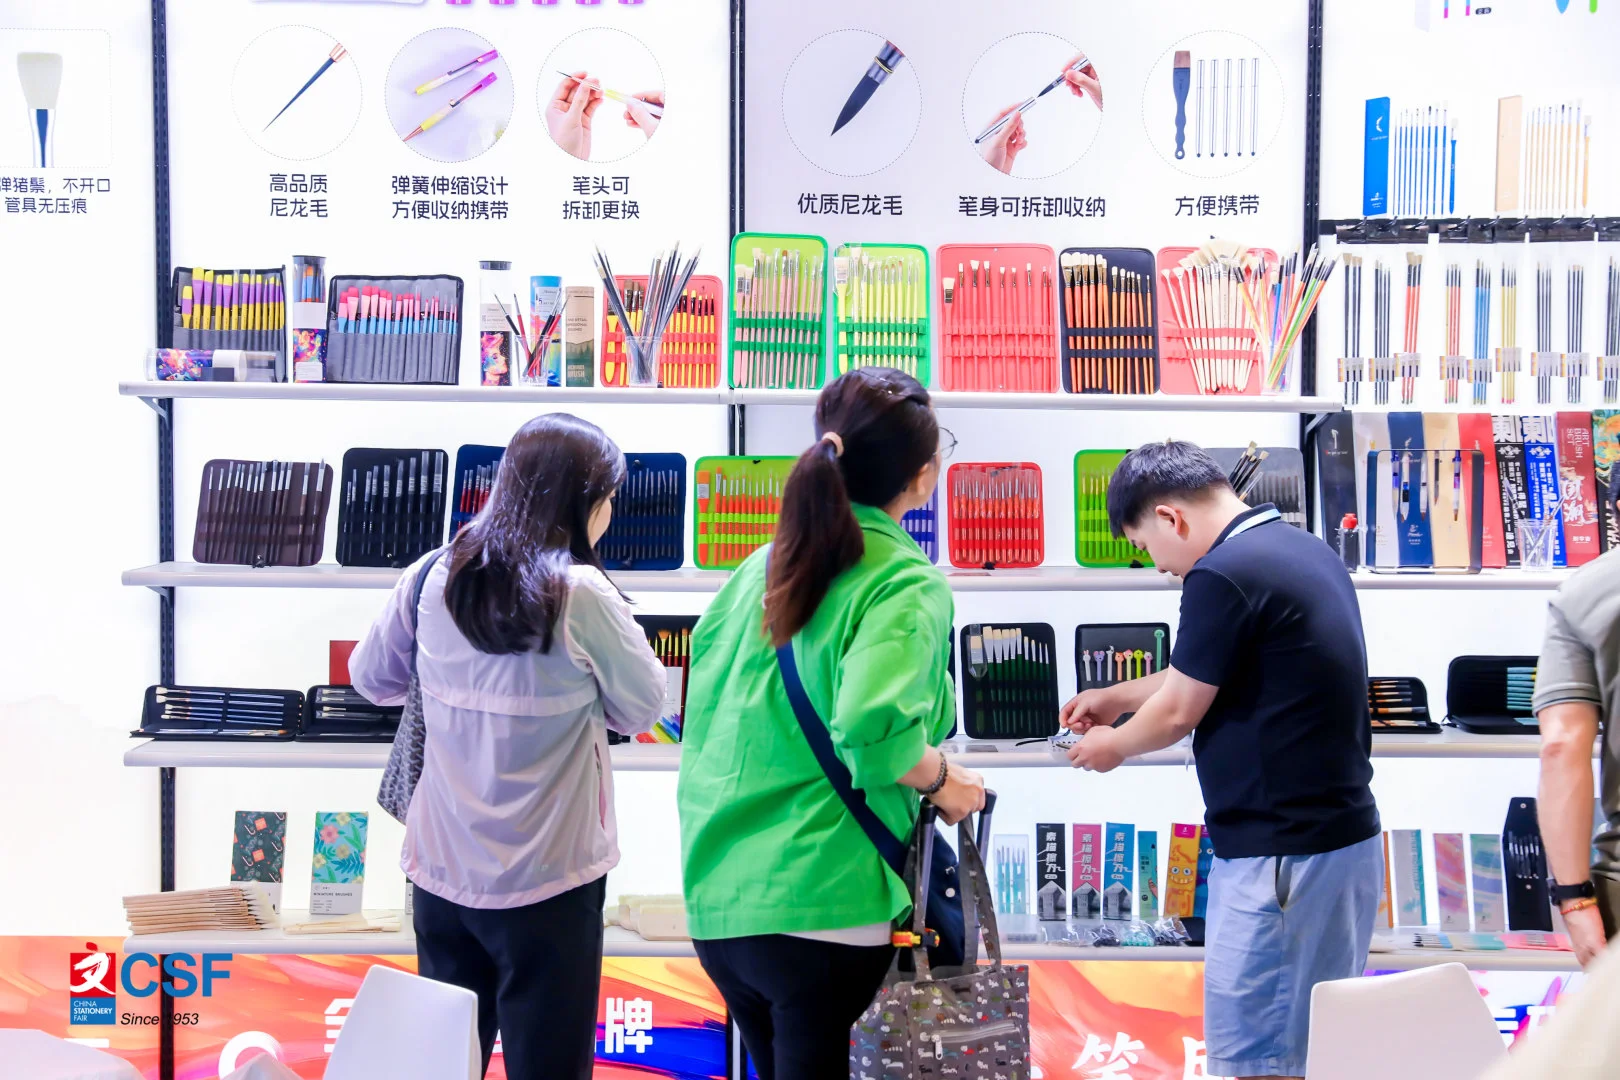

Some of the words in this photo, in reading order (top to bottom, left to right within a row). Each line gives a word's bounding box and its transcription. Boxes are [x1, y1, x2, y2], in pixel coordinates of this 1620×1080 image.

[270, 173, 328, 193] 高品质
[391, 175, 509, 195] 弹簧伸缩设计
[573, 176, 630, 195] 笔头可
[5, 197, 87, 213] 管具无压痕
[270, 198, 328, 217] 尼龙毛
[392, 200, 509, 220] 方便收纳携带
[563, 200, 640, 220] 拆卸更换
[797, 193, 903, 215] 优质尼龙毛
[958, 195, 1106, 218] 笔身可拆卸收纳
[1175, 195, 1260, 216] 方便携带
[1566, 427, 1575, 446] SET
[1574, 427, 1584, 459] BRUSH
[1581, 427, 1590, 447] ART
